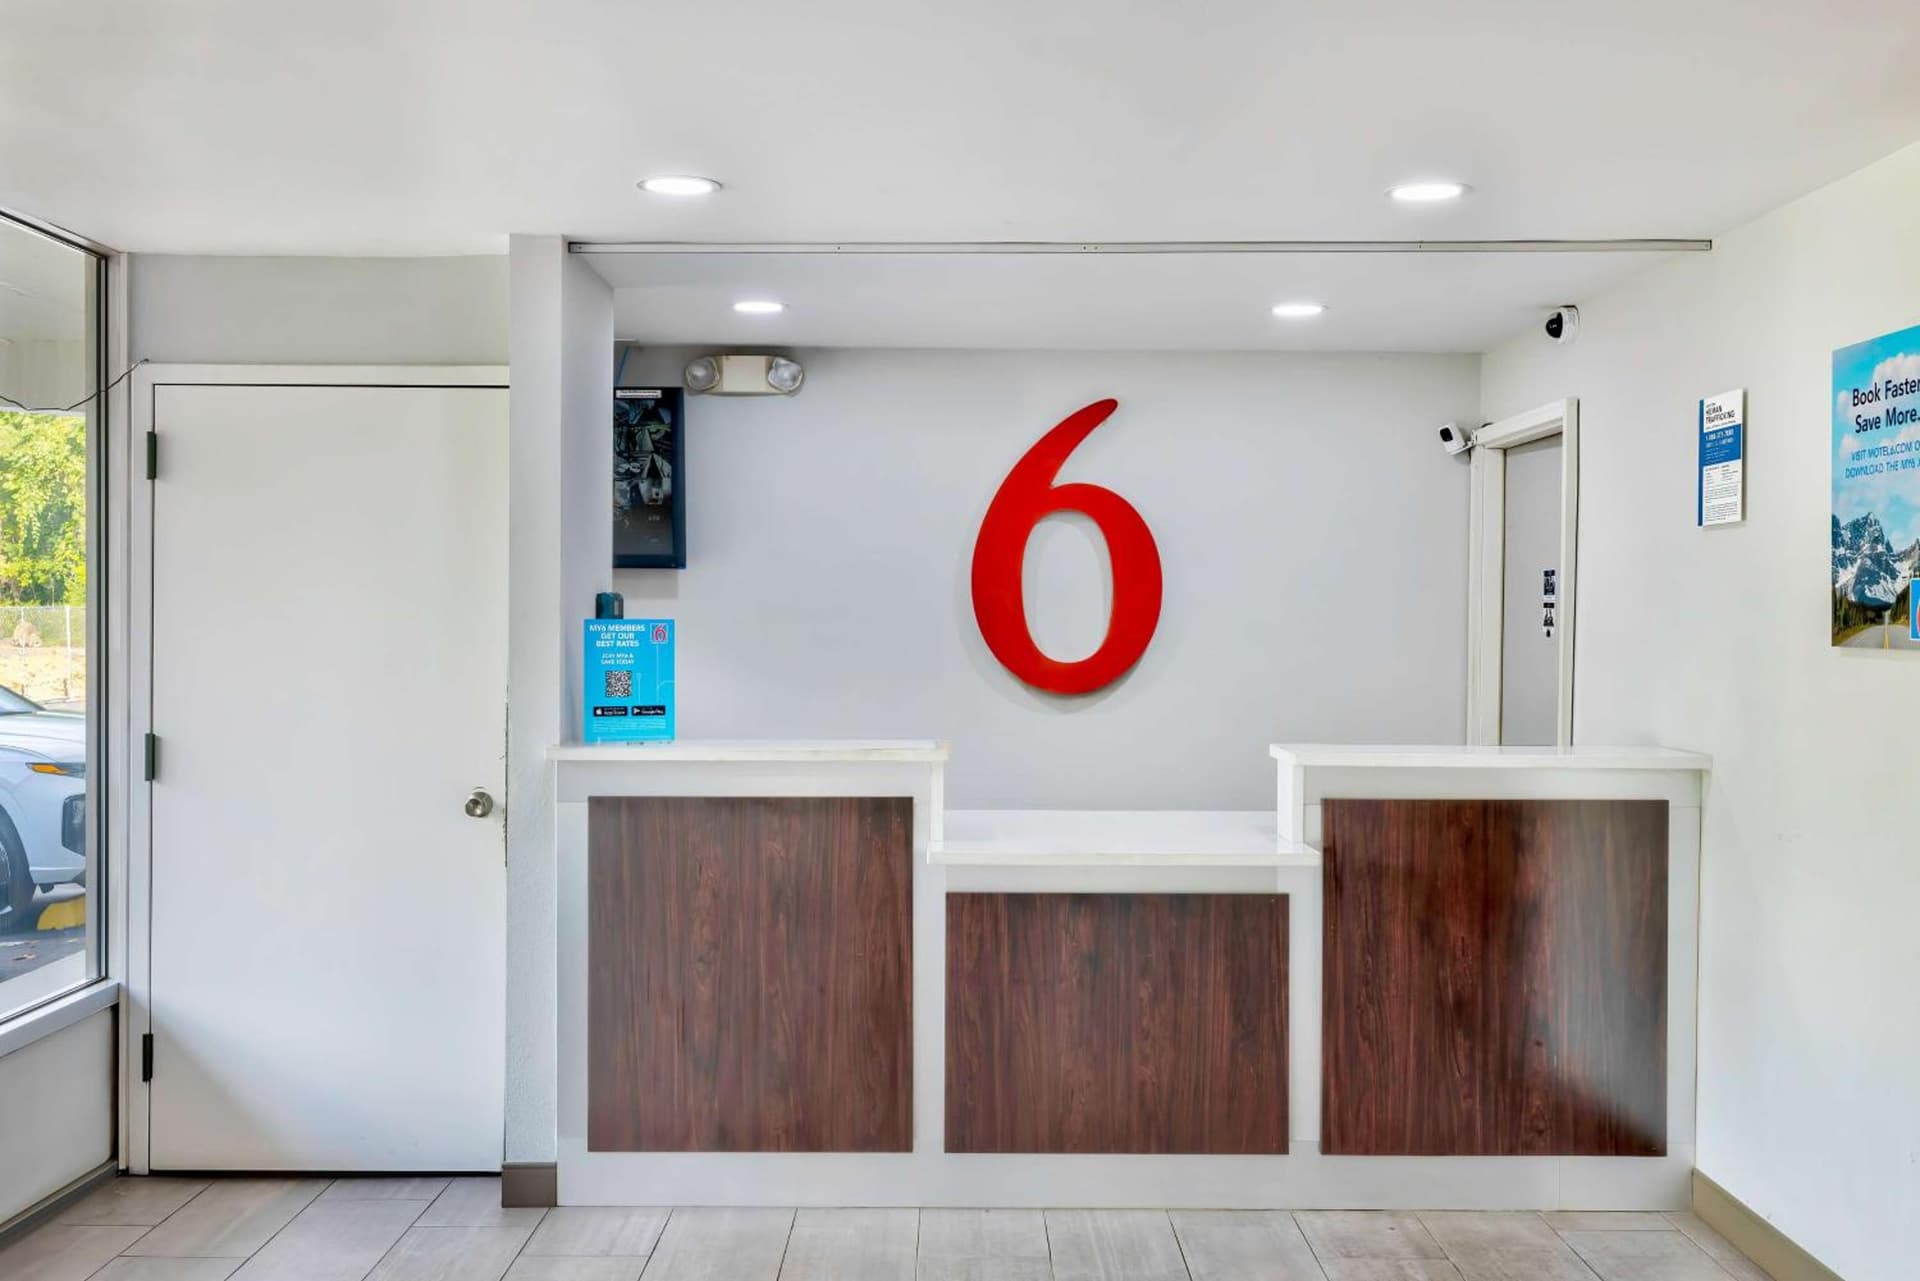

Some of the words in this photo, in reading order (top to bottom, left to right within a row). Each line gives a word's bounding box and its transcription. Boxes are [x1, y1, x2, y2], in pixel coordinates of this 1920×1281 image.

[1853, 382, 1880, 407] Book
[1706, 409, 1735, 424] TRAFFICKING
[1855, 414, 1881, 434] Save
[1852, 449, 1866, 461] VISIT
[1845, 462, 1884, 479] DOWNLOAD
[1886, 460, 1900, 471] THE
[971, 398, 1163, 695] 6
[654, 624, 667, 641] 6
